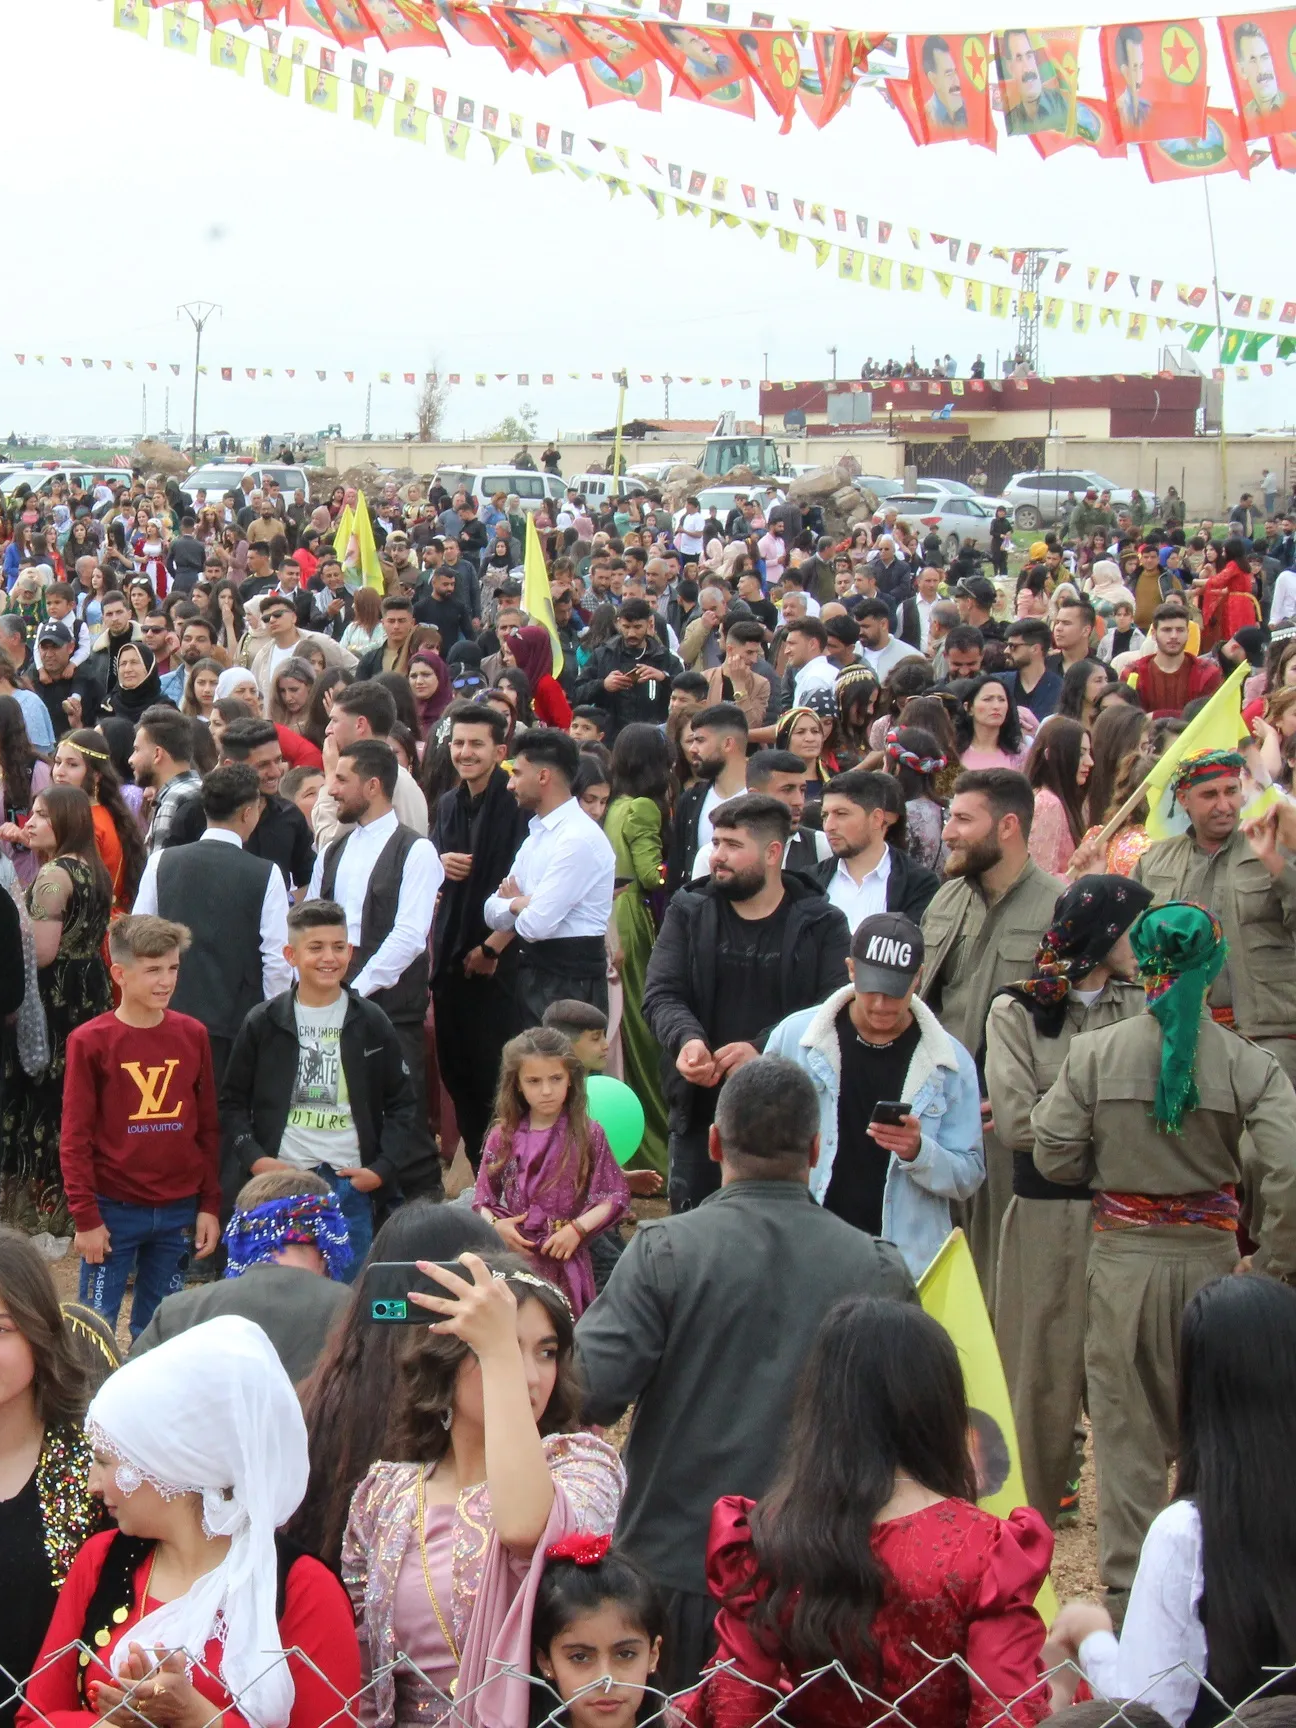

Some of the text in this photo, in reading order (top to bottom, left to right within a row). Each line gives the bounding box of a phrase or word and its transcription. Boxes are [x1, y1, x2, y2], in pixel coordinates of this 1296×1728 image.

[865, 935, 912, 968] KING
[127, 1122, 184, 1134] LOUIS VUITTON
[291, 1110, 348, 1129] UTURE
